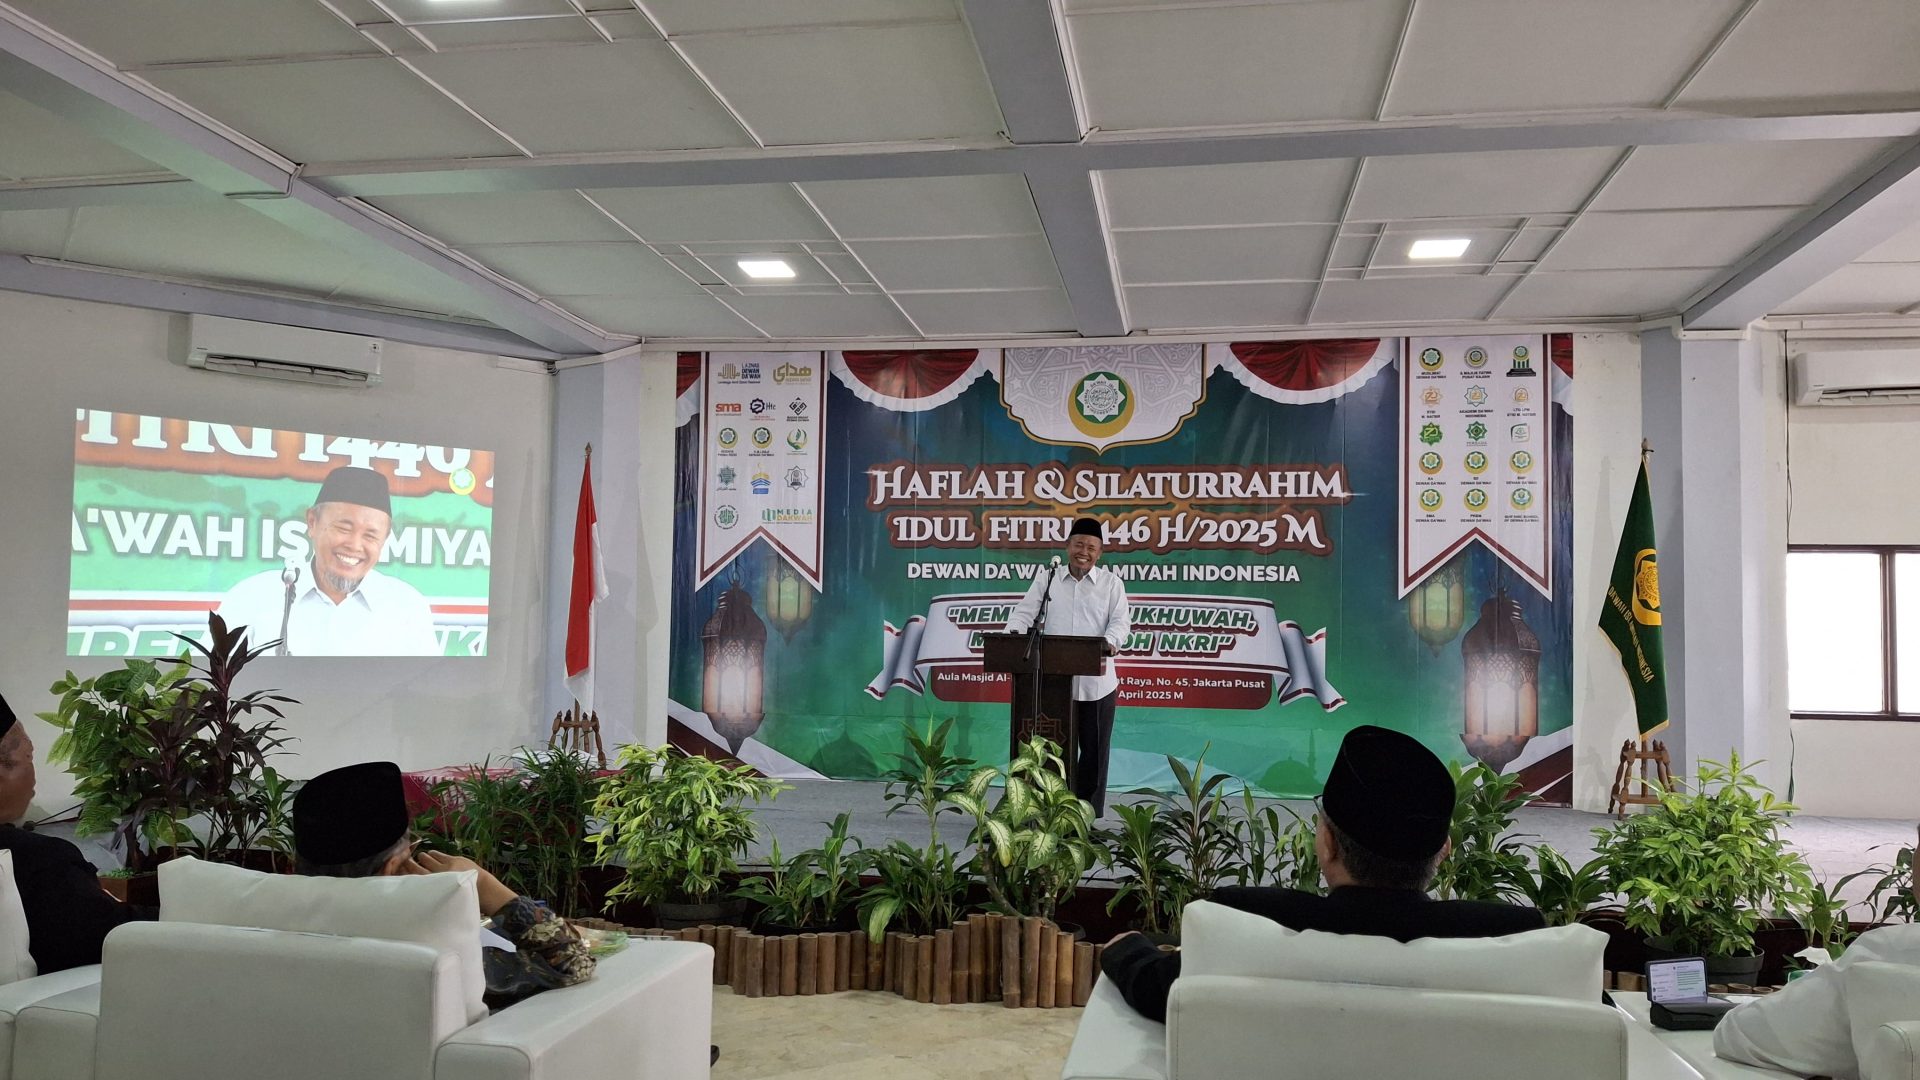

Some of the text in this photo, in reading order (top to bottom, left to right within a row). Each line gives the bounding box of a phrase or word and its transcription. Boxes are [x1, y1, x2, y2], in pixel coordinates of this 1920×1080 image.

[873, 466, 1344, 505] HAFLAH & SILATURRAHIM
[893, 516, 976, 542] IDUL
[1100, 516, 1151, 545] 446
[1157, 512, 1278, 548] H/2025
[1281, 513, 1326, 549] M
[907, 563, 980, 579] DEWAN
[984, 562, 1052, 580] DA'WA
[1183, 565, 1301, 582] INDONESIA
[937, 672, 960, 681] Aula
[961, 672, 994, 683] Masjid
[1126, 677, 1155, 687] Raya,
[1156, 678, 1173, 686] No.
[1175, 678, 1191, 687] 45,
[1193, 678, 1233, 687] Jakarta
[1234, 679, 1266, 688] Pusat
[1118, 690, 1184, 700] April 2025 M
